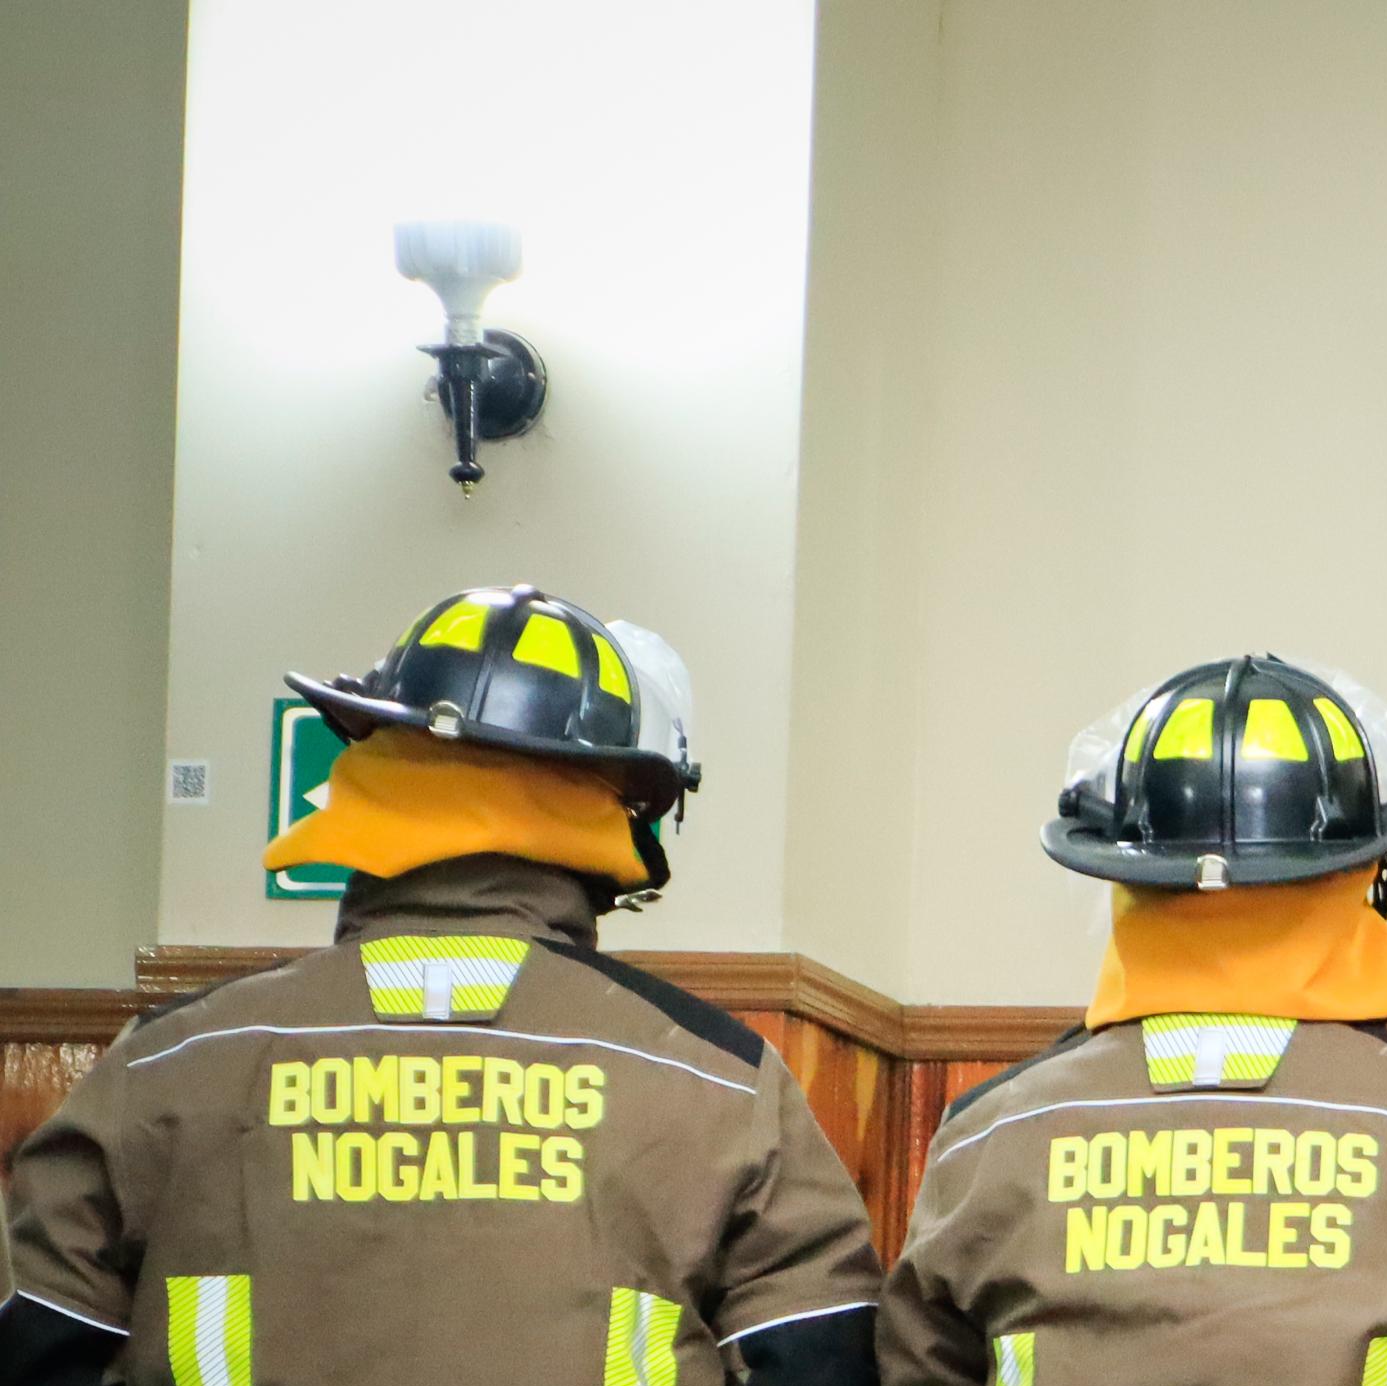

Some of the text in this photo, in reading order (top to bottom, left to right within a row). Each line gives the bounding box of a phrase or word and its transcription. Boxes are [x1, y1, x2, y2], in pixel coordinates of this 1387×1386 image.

[268, 1055, 605, 1131] BOMBEROS
[291, 1131, 585, 1203] NOGALES
[1047, 1127, 1379, 1203] BOMBEROS
[1064, 1203, 1354, 1275] NOGALES
